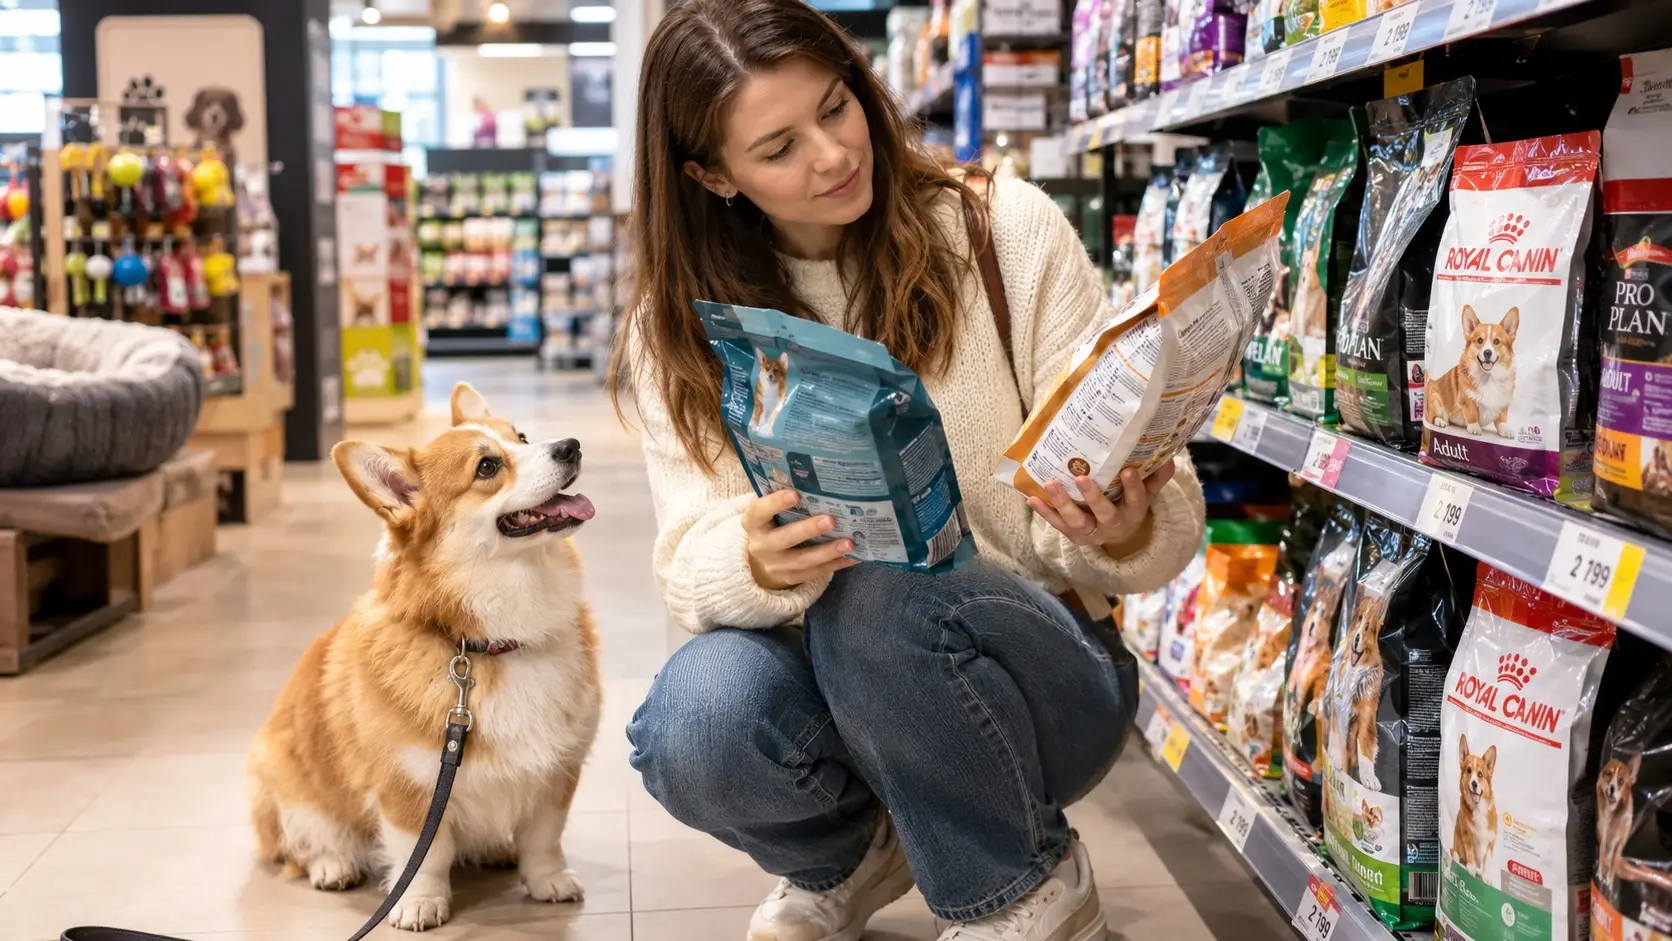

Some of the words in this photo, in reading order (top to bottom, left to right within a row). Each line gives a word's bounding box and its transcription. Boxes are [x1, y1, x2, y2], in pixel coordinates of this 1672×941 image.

[1384, 28, 1394, 46] 2
[1392, 22, 1411, 44] 199
[1444, 247, 1491, 273] ROYAL
[1496, 248, 1559, 273] CANIN
[1614, 281, 1655, 307] PRO
[1607, 306, 1667, 336] PLAN
[1433, 437, 1470, 462] Adult
[1433, 499, 1443, 519] 2
[1443, 502, 1462, 526] 199
[1569, 554, 1582, 578] 2
[1583, 559, 1610, 588] 199
[1455, 671, 1498, 712] ROYAL
[1502, 694, 1561, 734] CANIN
[1308, 904, 1317, 922] 2
[1315, 912, 1331, 939] 199
